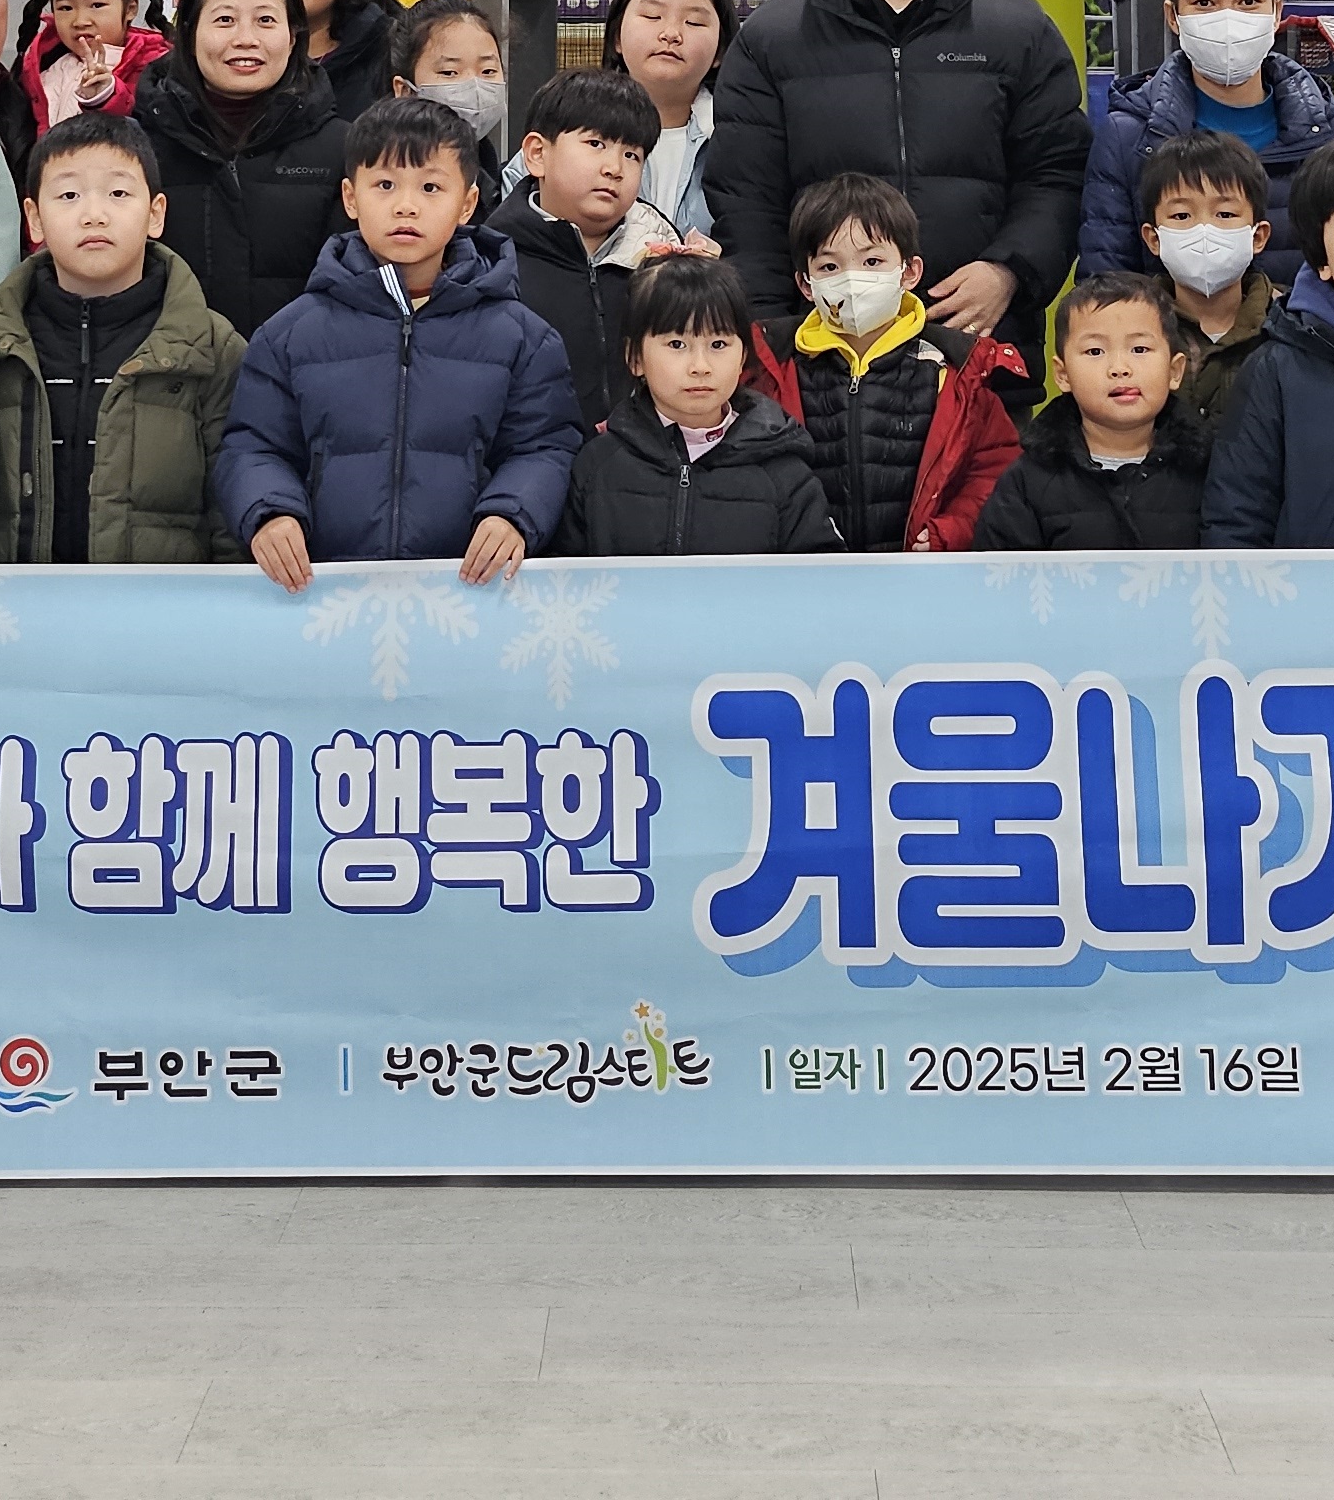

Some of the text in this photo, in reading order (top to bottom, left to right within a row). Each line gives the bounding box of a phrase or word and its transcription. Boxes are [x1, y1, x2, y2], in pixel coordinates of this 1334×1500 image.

[946, 52, 987, 62] Columbia
[61, 731, 293, 914] 함께
[311, 728, 662, 913] 행복한
[93, 1050, 282, 1101] 부안군
[382, 1040, 711, 1104] 부안군드림스타트
[787, 1047, 862, 1091] 일자
[908, 1046, 1086, 1093] 2025년
[1104, 1046, 1182, 1093] 2월
[1199, 1046, 1301, 1093] 16일
